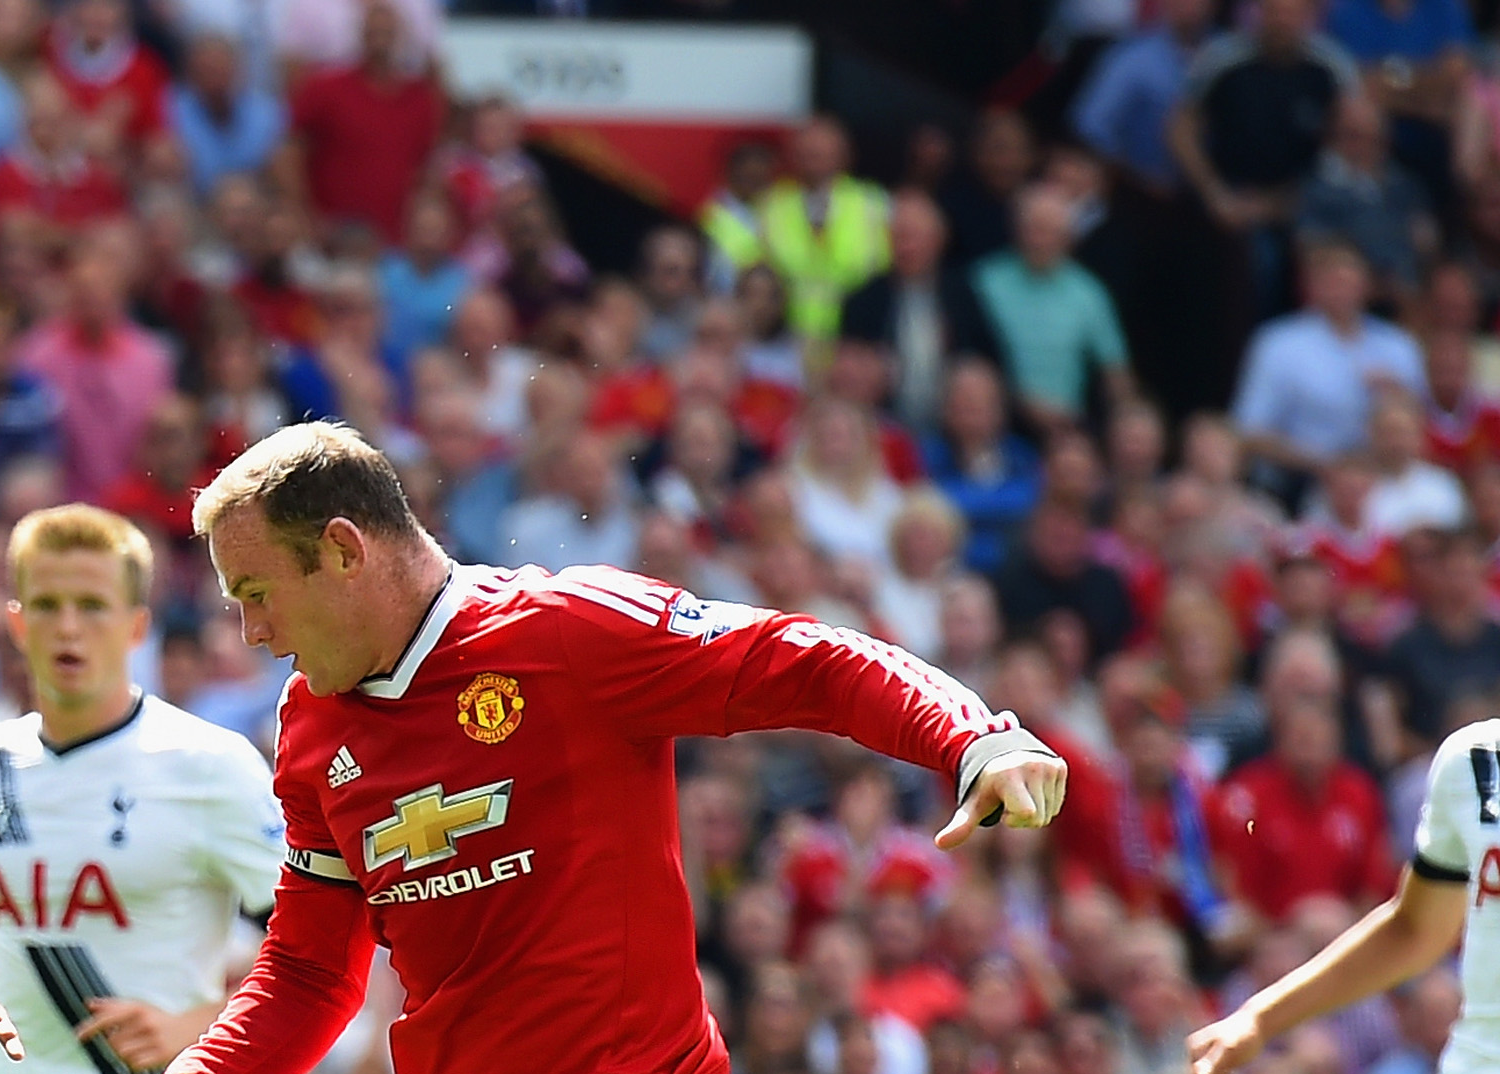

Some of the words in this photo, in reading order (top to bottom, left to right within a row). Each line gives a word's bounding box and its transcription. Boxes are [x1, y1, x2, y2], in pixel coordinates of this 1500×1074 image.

[475, 721, 515, 739] UNITED
[328, 765, 362, 788] adidas
[367, 849, 534, 905] CHEVROLET
